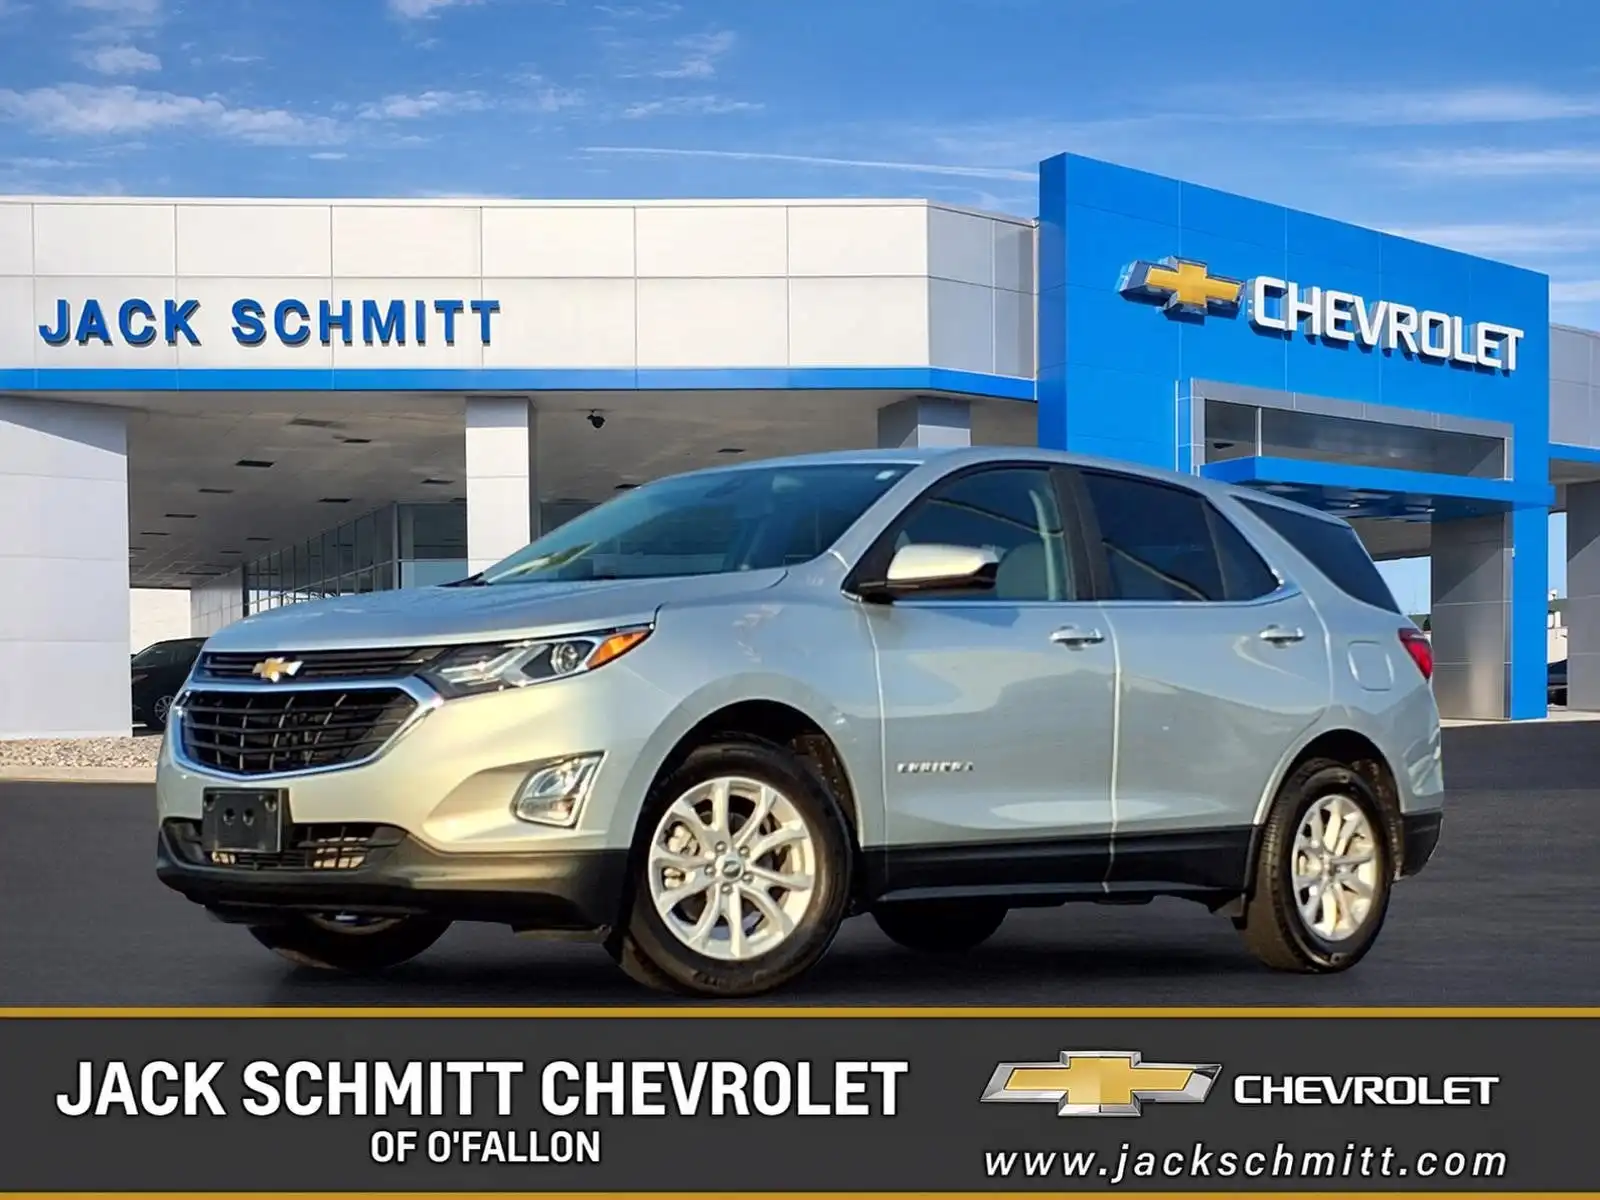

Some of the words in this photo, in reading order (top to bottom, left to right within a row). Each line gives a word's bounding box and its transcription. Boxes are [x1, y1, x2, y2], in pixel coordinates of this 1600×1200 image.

[39, 299, 200, 346] JACK
[231, 299, 501, 346] SCHMITT
[1248, 276, 1524, 371] CHEVROLET
